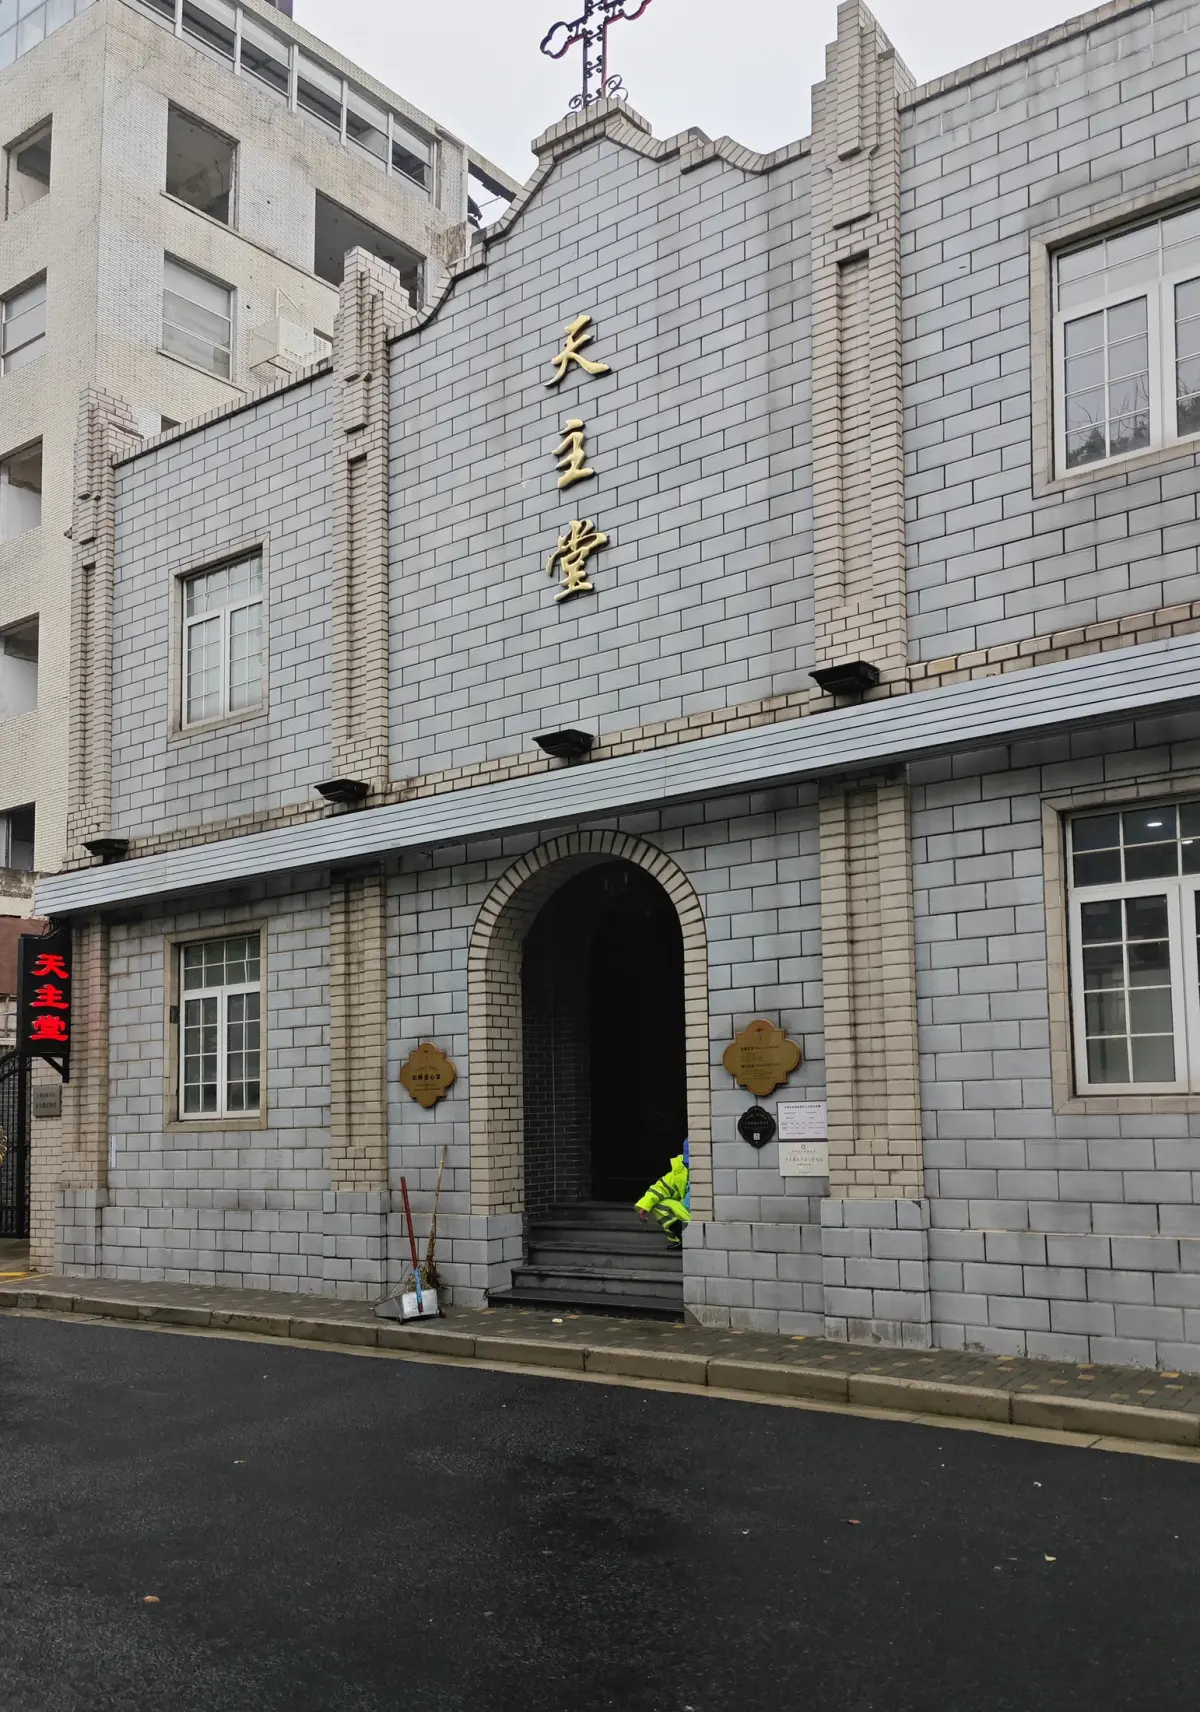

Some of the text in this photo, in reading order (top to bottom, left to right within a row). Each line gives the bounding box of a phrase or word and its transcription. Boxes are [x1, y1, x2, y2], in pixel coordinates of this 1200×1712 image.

[544, 314, 611, 603] 天主堂
[29, 953, 69, 1041] 天主堂
